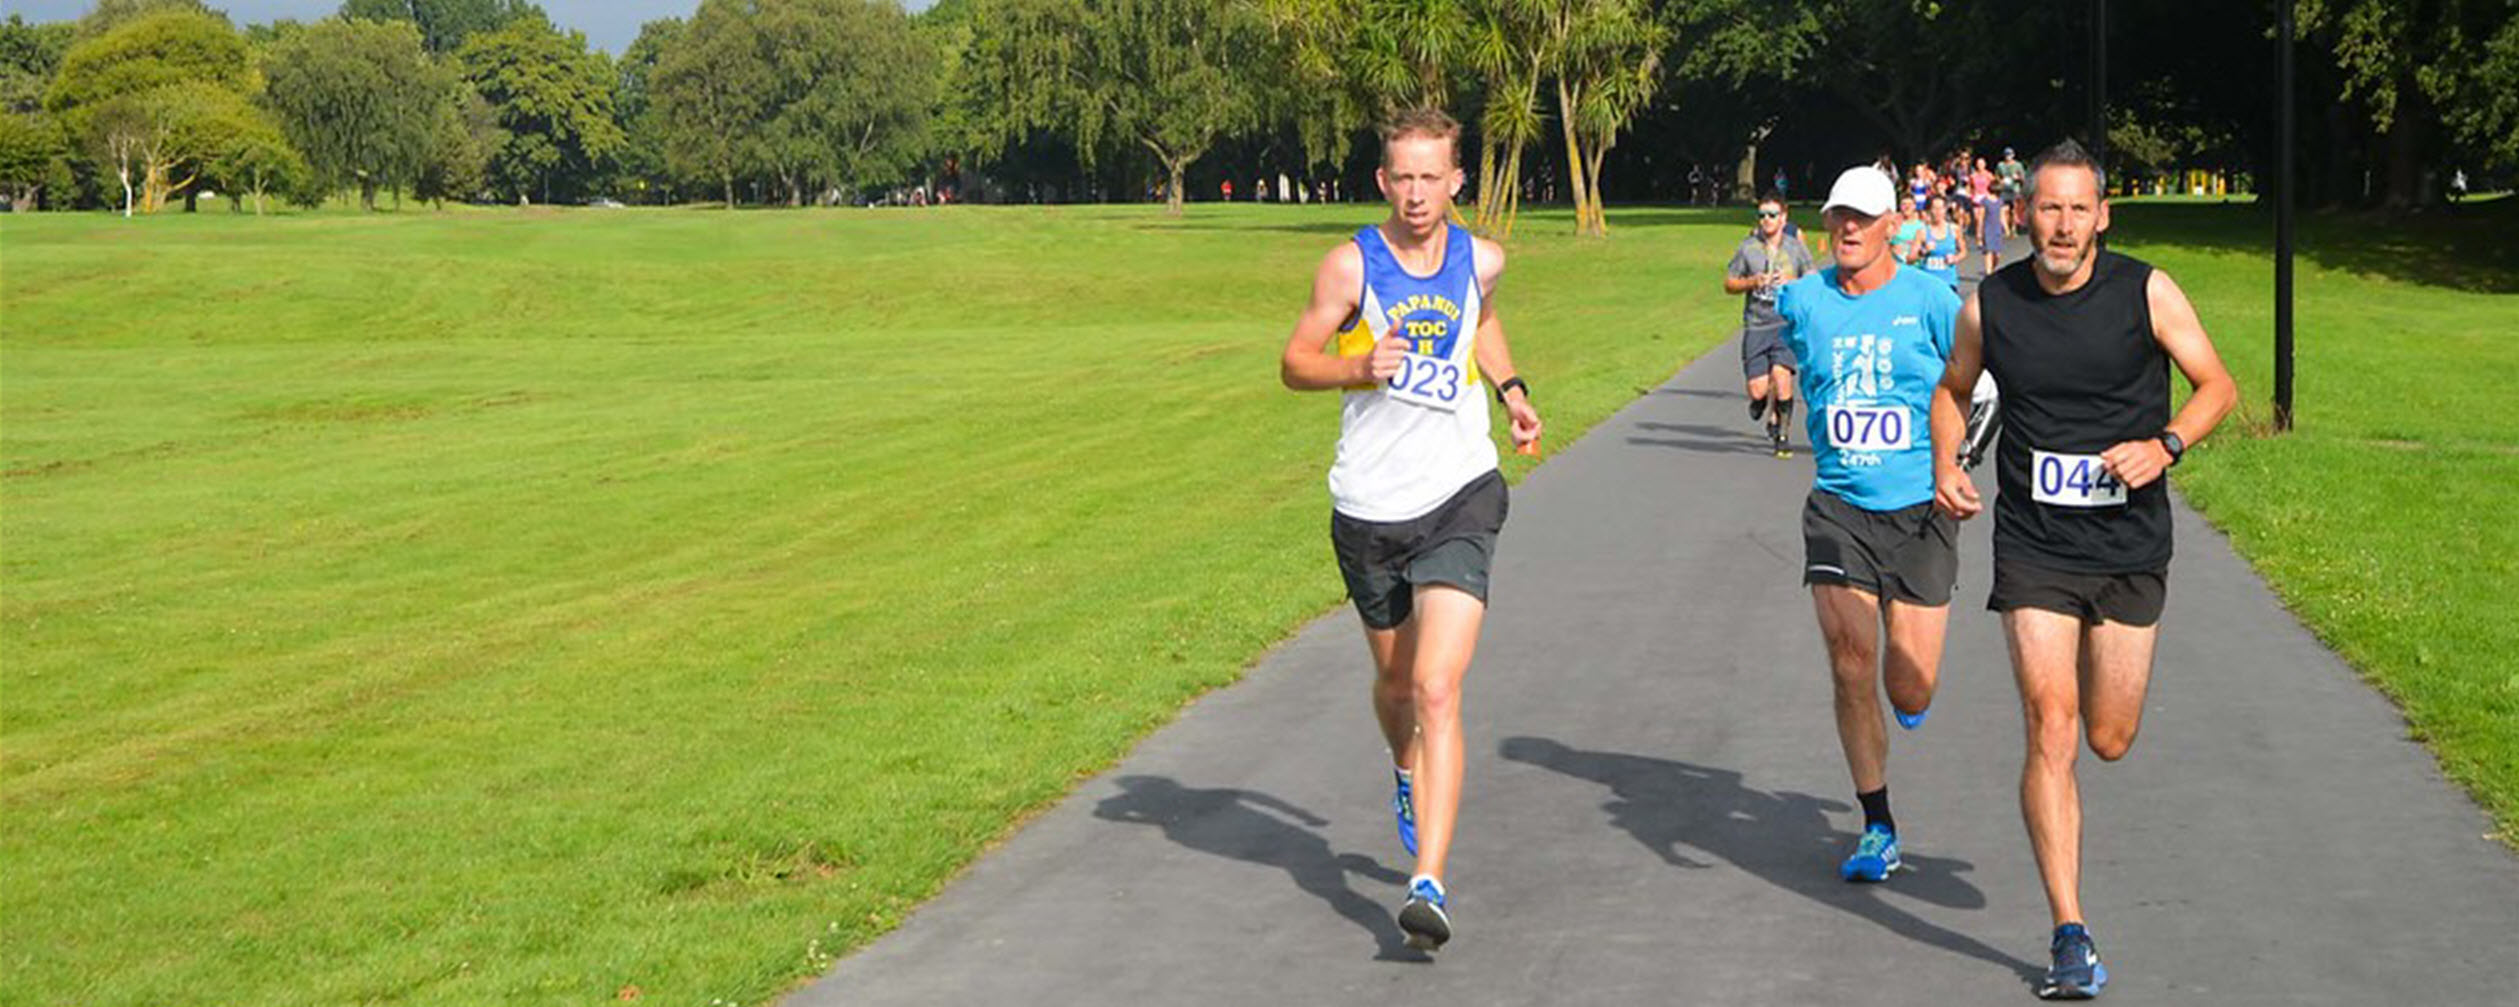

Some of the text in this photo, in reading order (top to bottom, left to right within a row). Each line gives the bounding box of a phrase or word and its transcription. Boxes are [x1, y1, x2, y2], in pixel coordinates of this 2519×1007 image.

[1387, 294, 1460, 321] PAPANUI
[1406, 321, 1447, 337] TOC
[1418, 339, 1434, 355] H
[1388, 354, 1459, 402] 023
[1833, 409, 1902, 445] 070
[2039, 456, 2121, 498] 044
